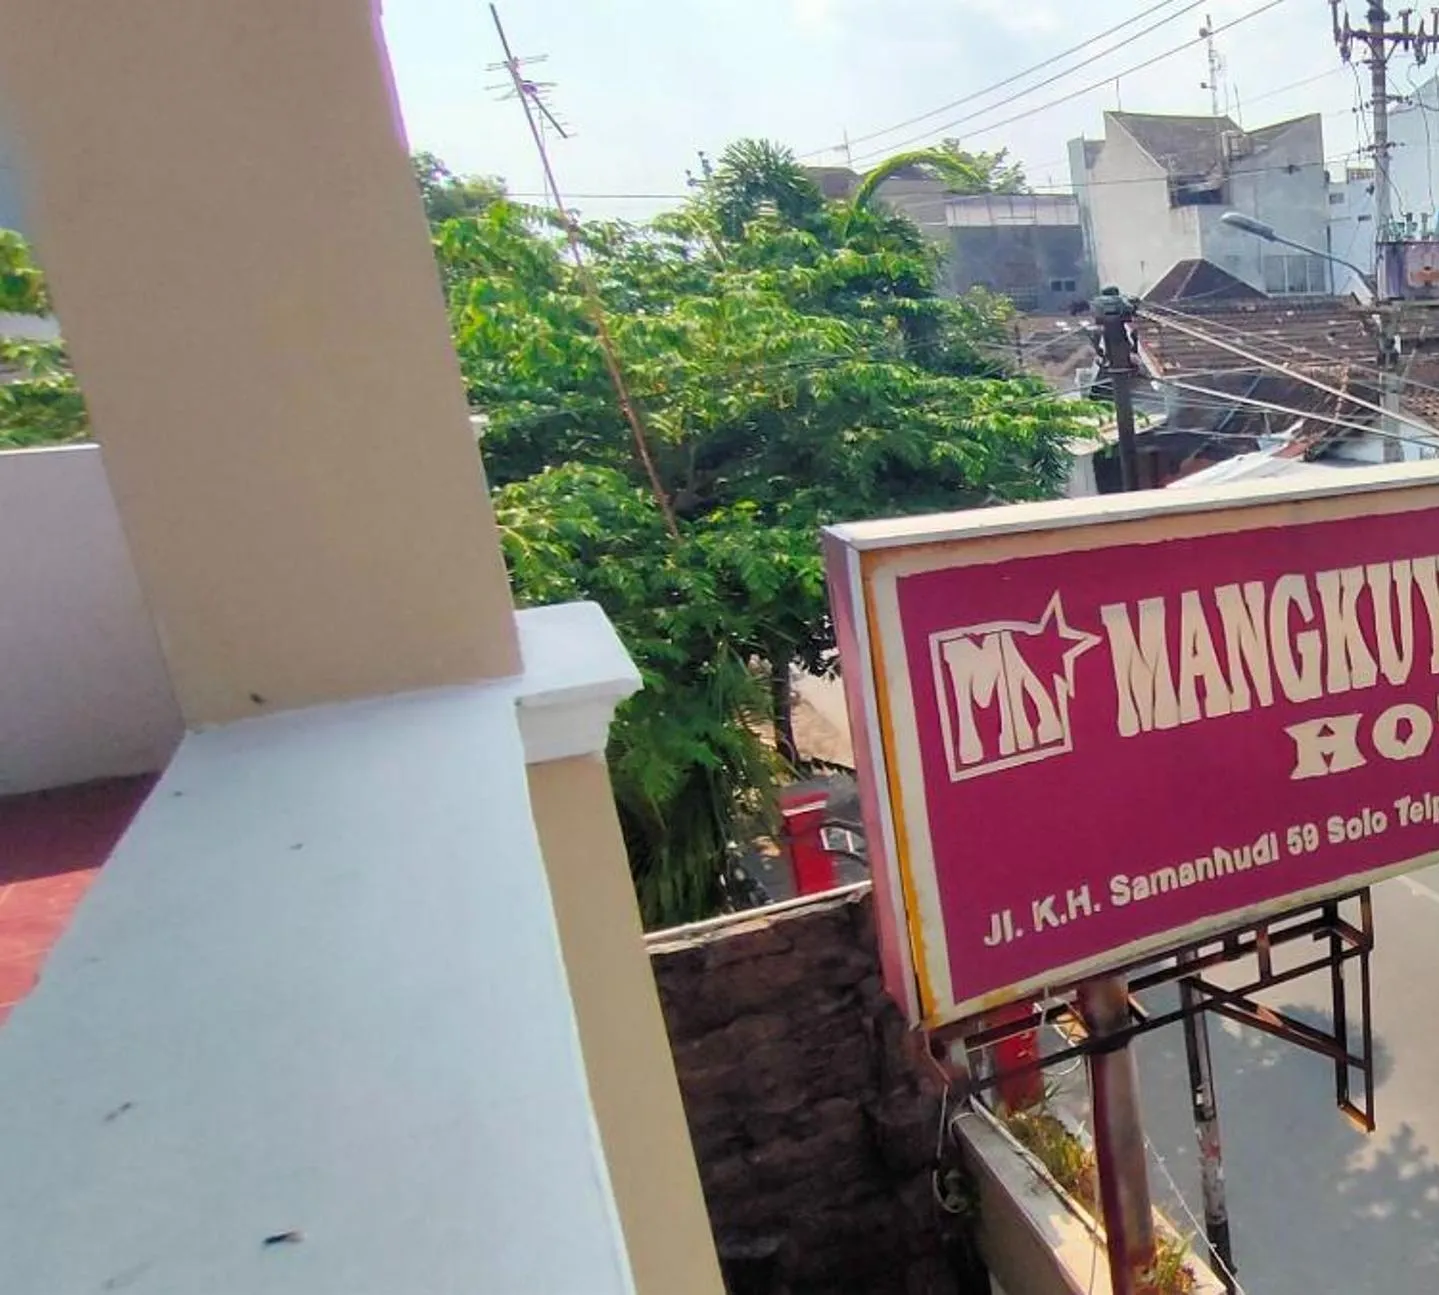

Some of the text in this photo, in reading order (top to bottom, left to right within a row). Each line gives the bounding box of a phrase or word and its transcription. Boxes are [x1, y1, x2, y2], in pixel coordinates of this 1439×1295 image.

[1032, 886, 1101, 932] K.H.
[1110, 832, 1280, 906] Samanhudi
[1287, 822, 1319, 855] 59
[1327, 807, 1388, 844] Solo
